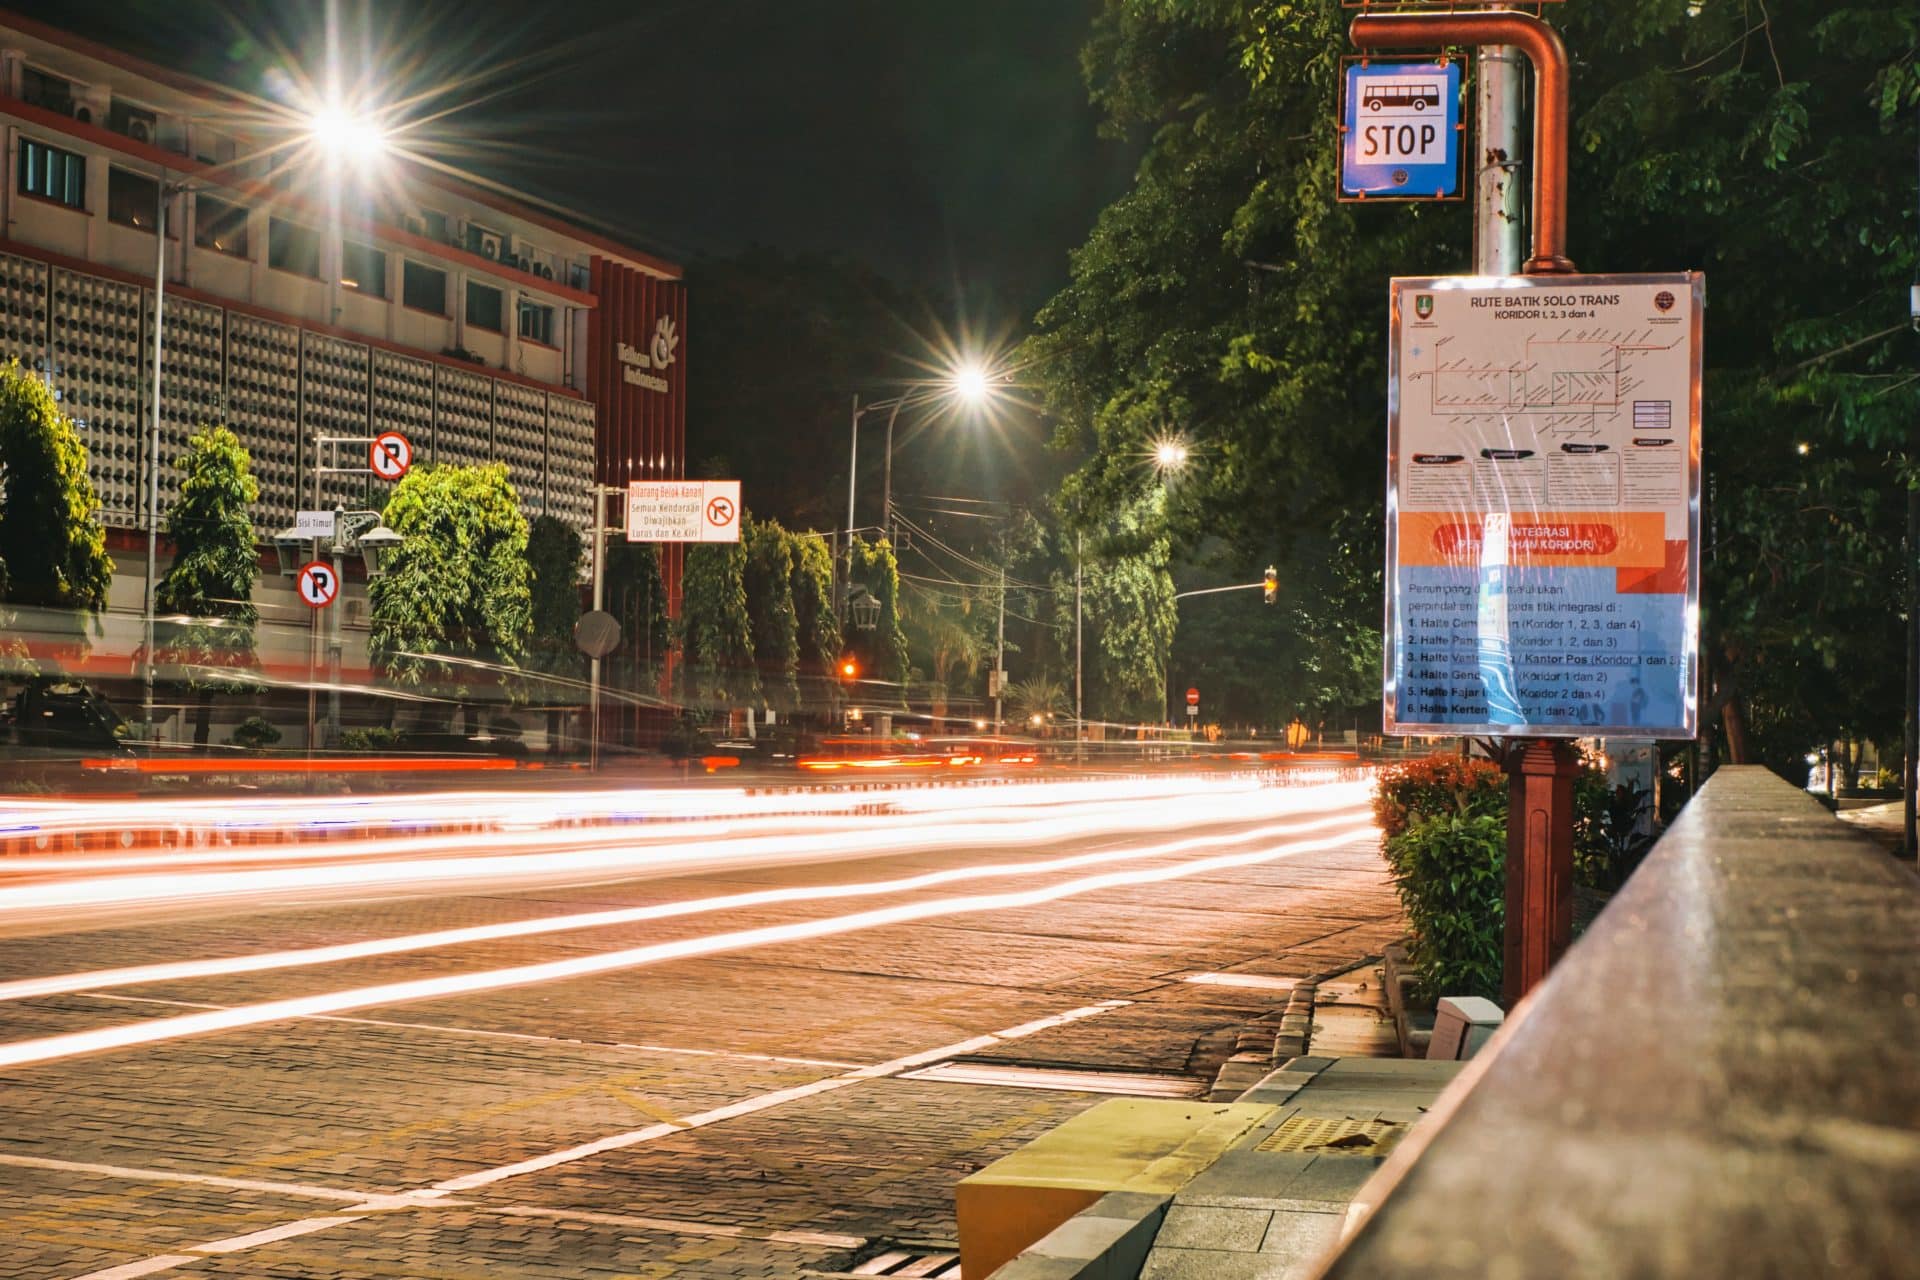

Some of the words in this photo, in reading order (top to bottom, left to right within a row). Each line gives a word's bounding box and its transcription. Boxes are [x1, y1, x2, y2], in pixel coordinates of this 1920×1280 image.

[1364, 124, 1436, 156] STOP
[1471, 297, 1502, 308] RUTE
[1505, 296, 1541, 307] BATIK
[1543, 295, 1576, 306] SOLO
[1579, 294, 1620, 306] TRANS
[1494, 310, 1540, 320] KORIDOR
[1550, 310, 1559, 320] 2,
[1560, 310, 1567, 319] 3
[1568, 309, 1587, 319] dan
[1588, 309, 1595, 318] 4
[631, 503, 656, 513] Semua
[659, 503, 700, 513] Kendaraan
[298, 518, 311, 528] Sisi
[312, 518, 333, 528] Timur
[655, 528, 670, 538] dan
[1558, 602, 1603, 614] integrasi
[1606, 602, 1616, 612] di
[1421, 618, 1449, 628] Halte
[1606, 620, 1627, 630] dan
[1629, 620, 1641, 632] 4)
[1420, 635, 1449, 645] Halte
[1583, 637, 1604, 647] dan
[1606, 637, 1617, 648] 3)
[1420, 652, 1448, 662] Halte
[1525, 653, 1563, 664] Kantor
[1566, 654, 1588, 664] Pos
[1646, 656, 1666, 665] dan
[1420, 669, 1448, 680] Halte
[1573, 672, 1593, 682] dan
[1596, 672, 1608, 684] 2)
[1420, 687, 1448, 697] Halte
[1451, 687, 1480, 699] Fajar
[1561, 689, 1569, 699] 2
[1571, 689, 1591, 699] dan
[1594, 690, 1605, 701] 4)
[1419, 704, 1448, 714] Halte
[1451, 704, 1488, 715] Kerten
[1545, 706, 1566, 717] dan
